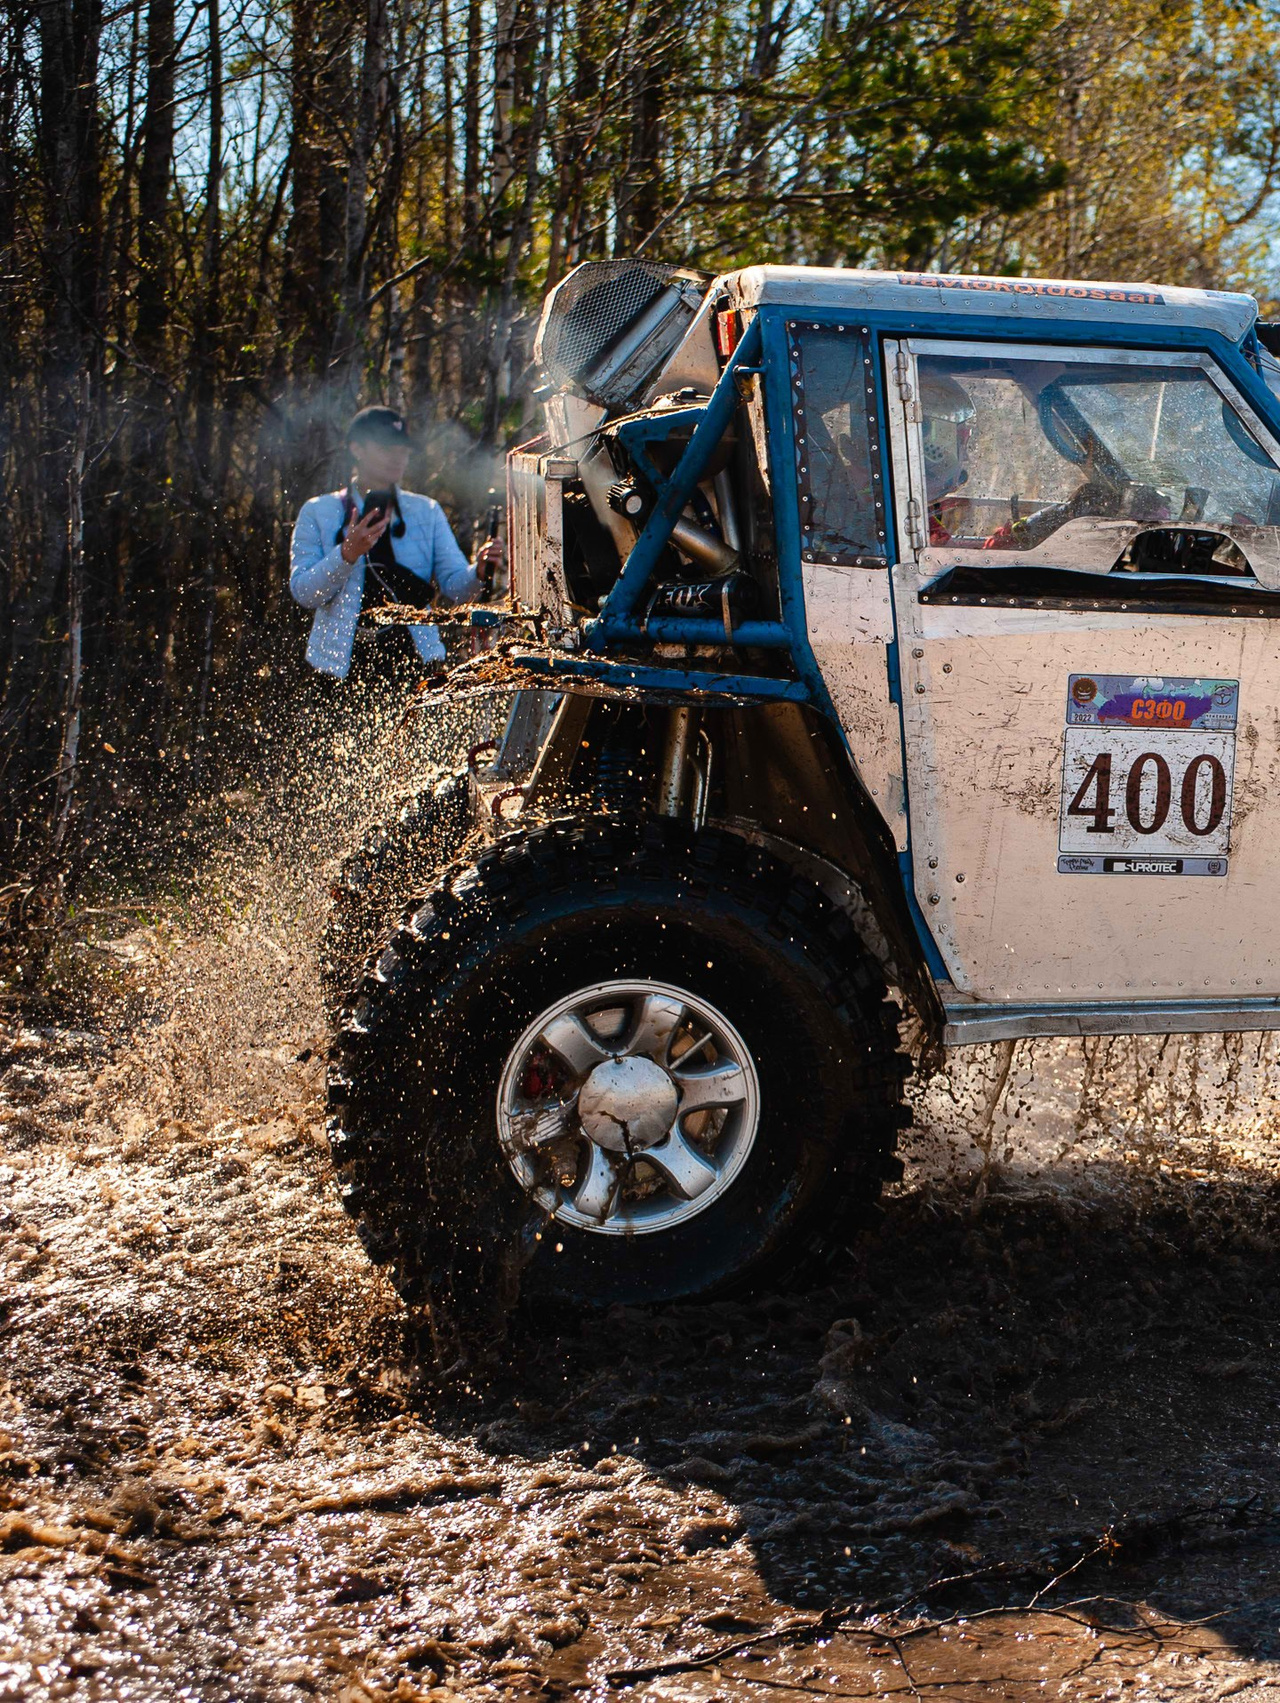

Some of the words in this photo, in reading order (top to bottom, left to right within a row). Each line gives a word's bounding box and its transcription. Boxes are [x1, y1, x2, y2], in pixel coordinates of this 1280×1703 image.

[1131, 698, 1186, 720] СЗФО
[1074, 713, 1092, 722] 2022
[1067, 751, 1227, 836] 400
[1124, 862, 1177, 873] SUPROTEC
